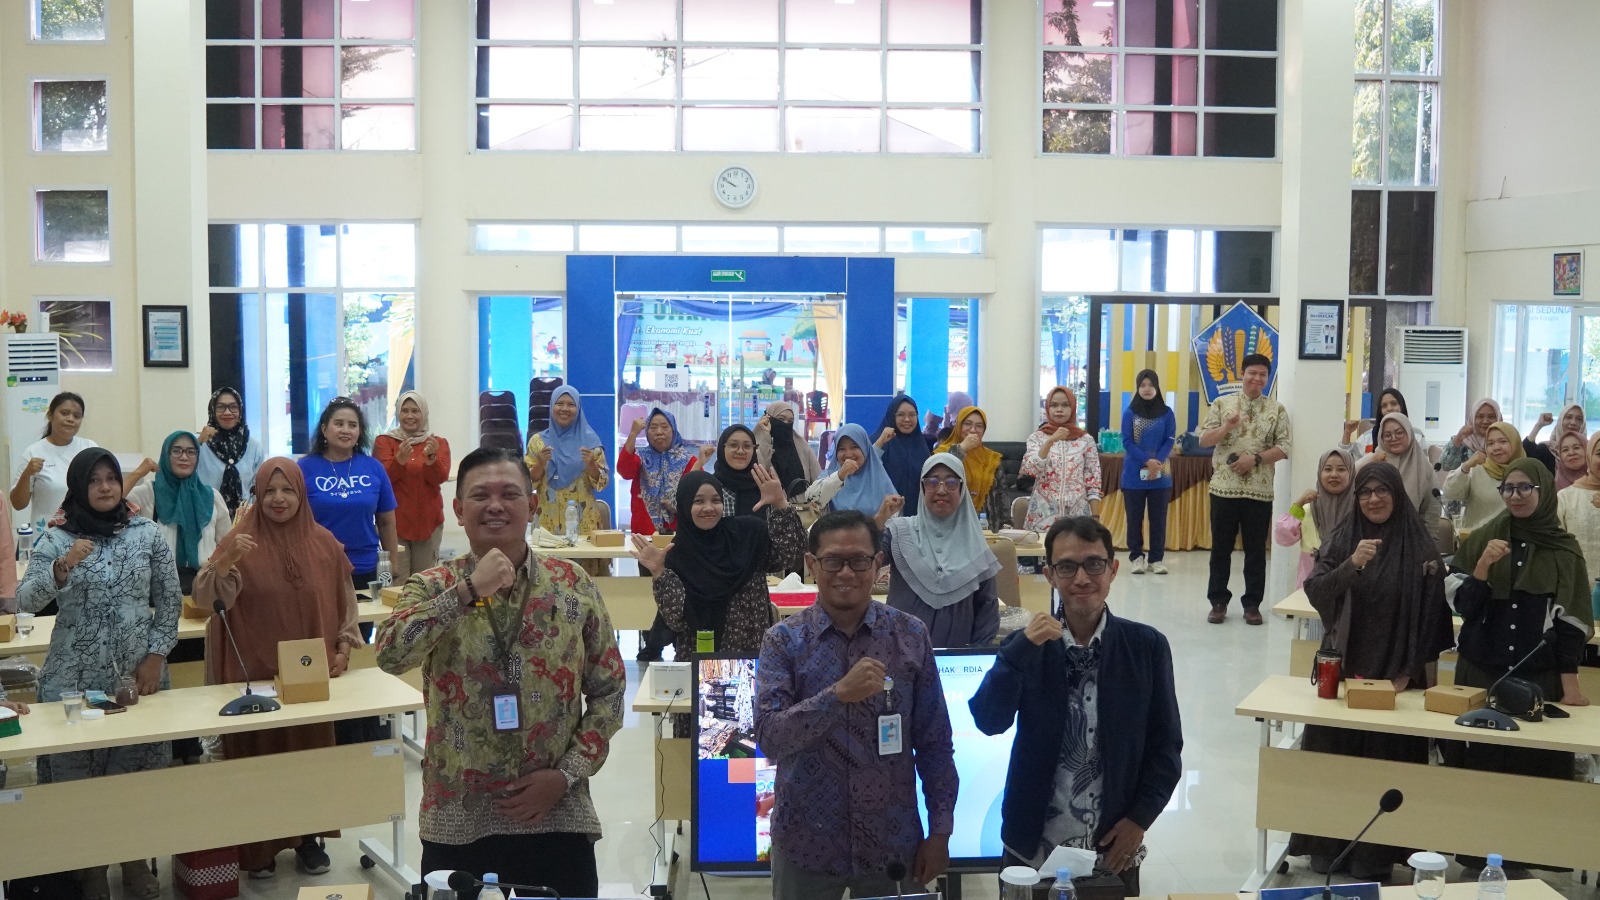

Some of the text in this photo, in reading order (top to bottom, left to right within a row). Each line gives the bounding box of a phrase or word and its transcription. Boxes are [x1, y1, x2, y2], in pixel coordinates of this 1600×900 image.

[1536, 305, 1572, 314] SEDUNIA
[645, 325, 681, 335] Ekonomi
[682, 327, 703, 335] Kuat
[337, 475, 372, 489] AFC
